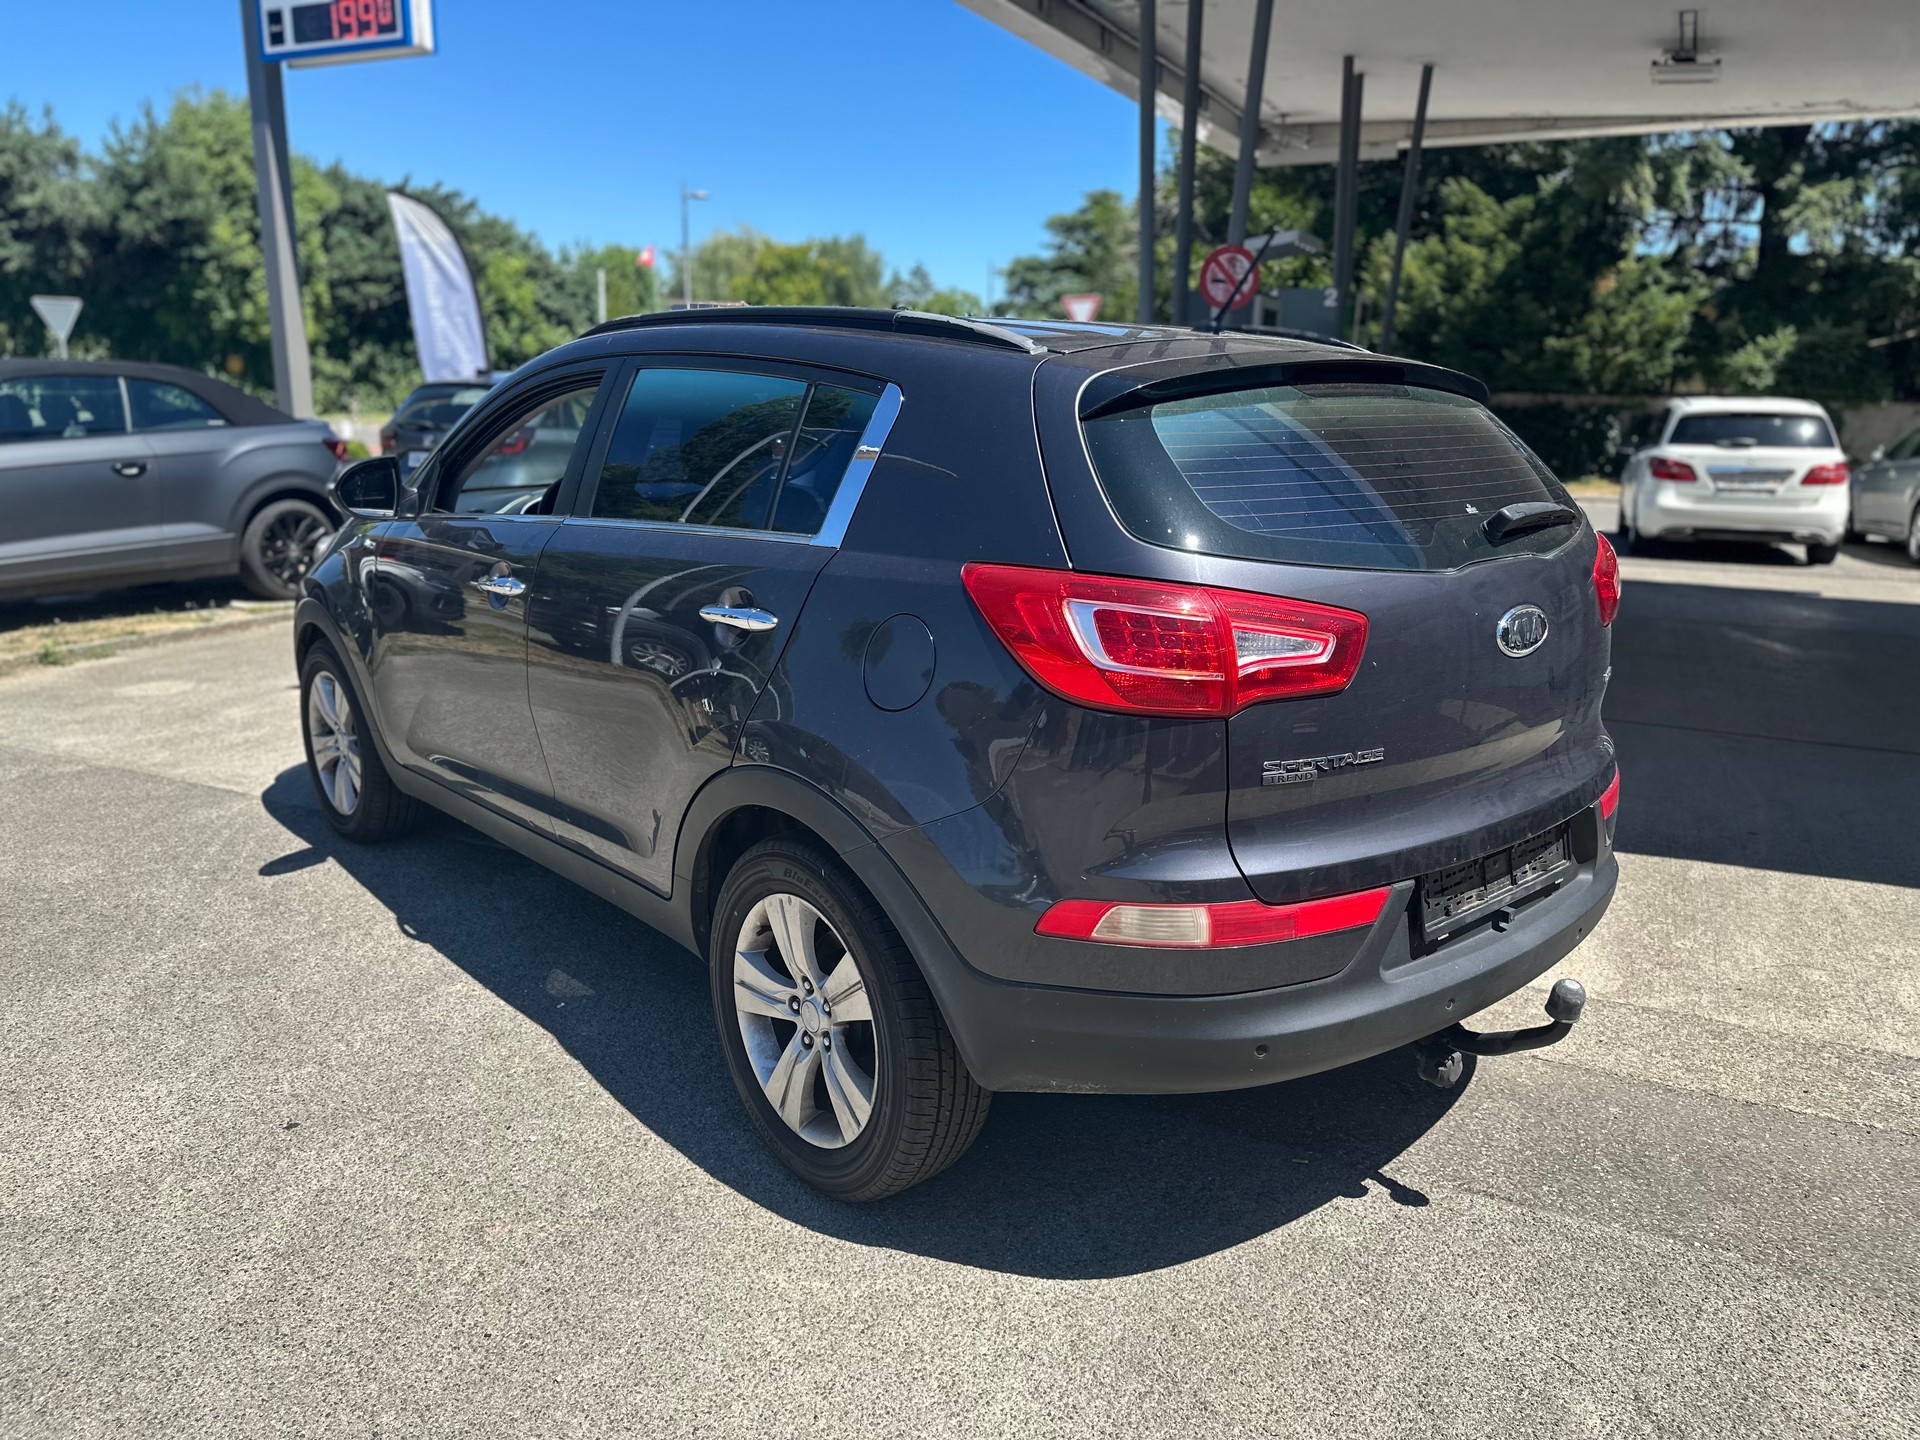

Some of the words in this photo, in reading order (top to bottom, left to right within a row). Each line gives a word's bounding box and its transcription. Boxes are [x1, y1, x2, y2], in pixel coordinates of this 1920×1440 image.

[1323, 288, 1339, 307] 2
[1507, 614, 1544, 648] KIA
[1262, 748, 1385, 775] SPORTAGE
[1268, 772, 1314, 784] TREND
